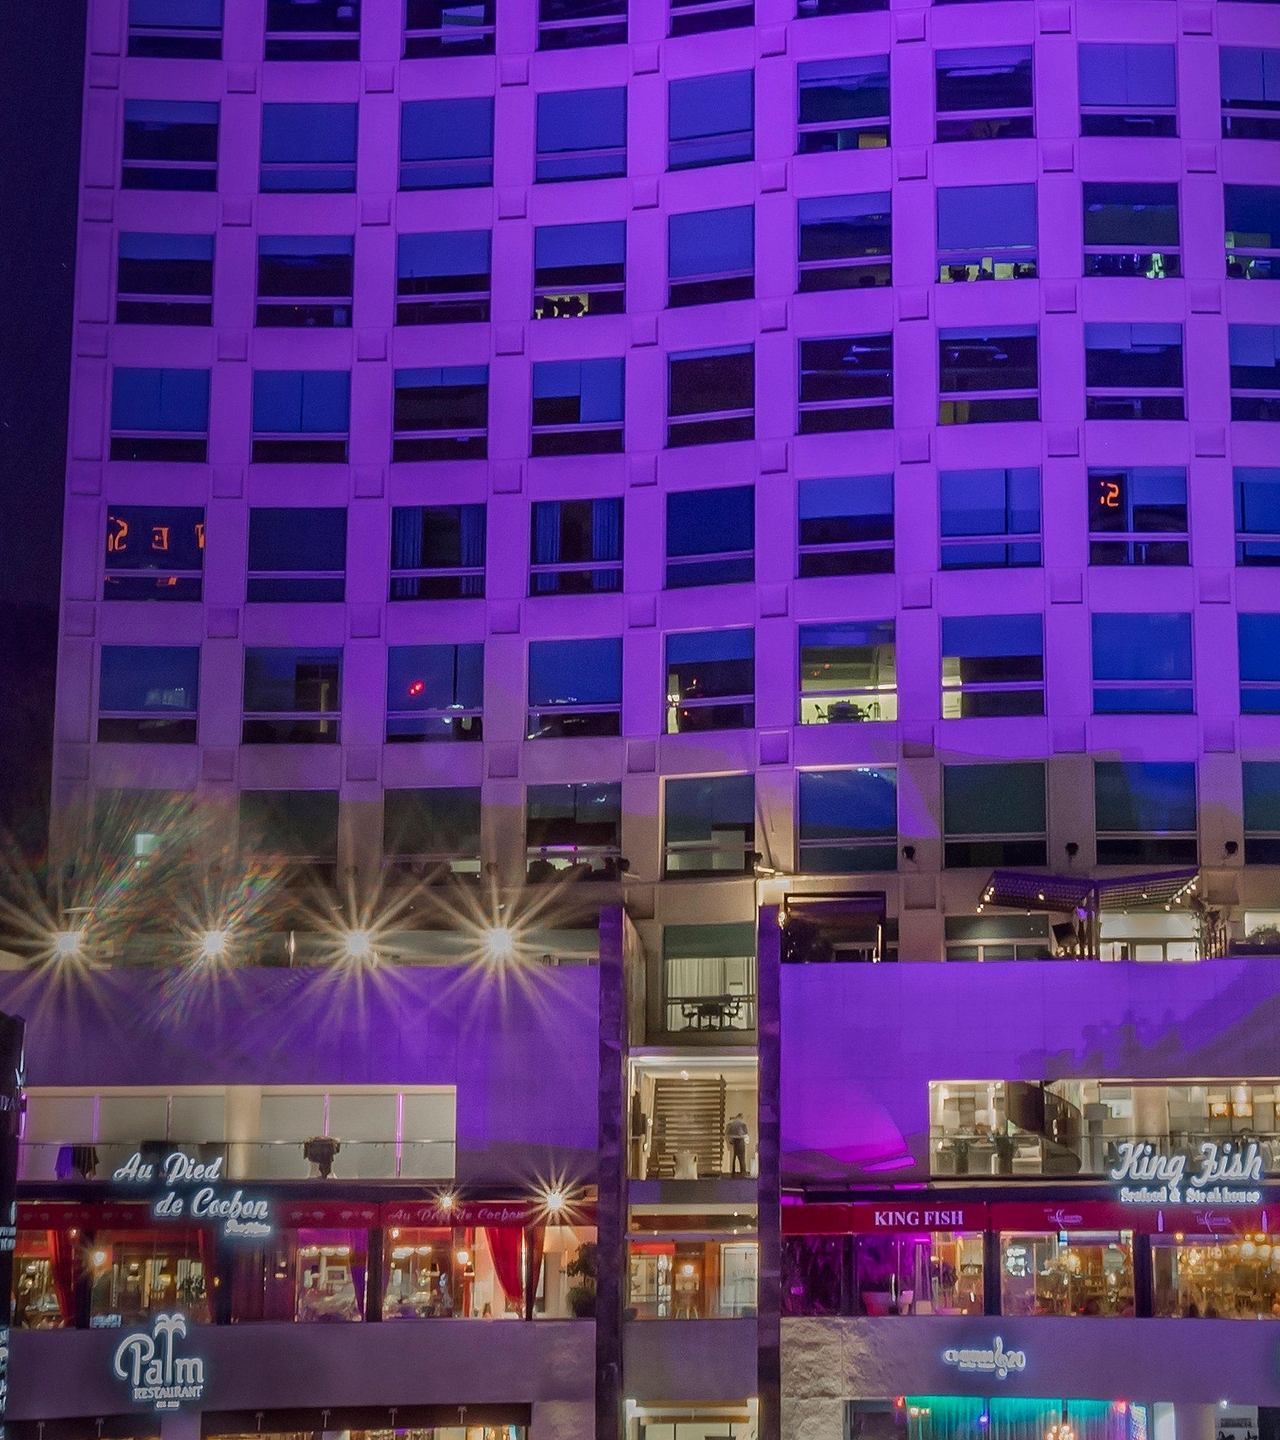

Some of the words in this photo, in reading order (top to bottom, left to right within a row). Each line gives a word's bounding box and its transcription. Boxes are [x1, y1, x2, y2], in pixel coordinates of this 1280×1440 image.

[113, 1152, 153, 1182] Au
[164, 1152, 224, 1185] Pied
[1111, 1142, 1186, 1189] King
[1191, 1142, 1263, 1187] Fish
[153, 1191, 185, 1217] de
[191, 1187, 269, 1220] Cochon
[1121, 1185, 1167, 1203] Seafood
[1169, 1186, 1181, 1203] &
[874, 1210, 920, 1226] KING
[924, 1210, 964, 1226] FISH
[114, 1313, 204, 1386] Palm
[133, 1384, 204, 1400] RESTAURANT
